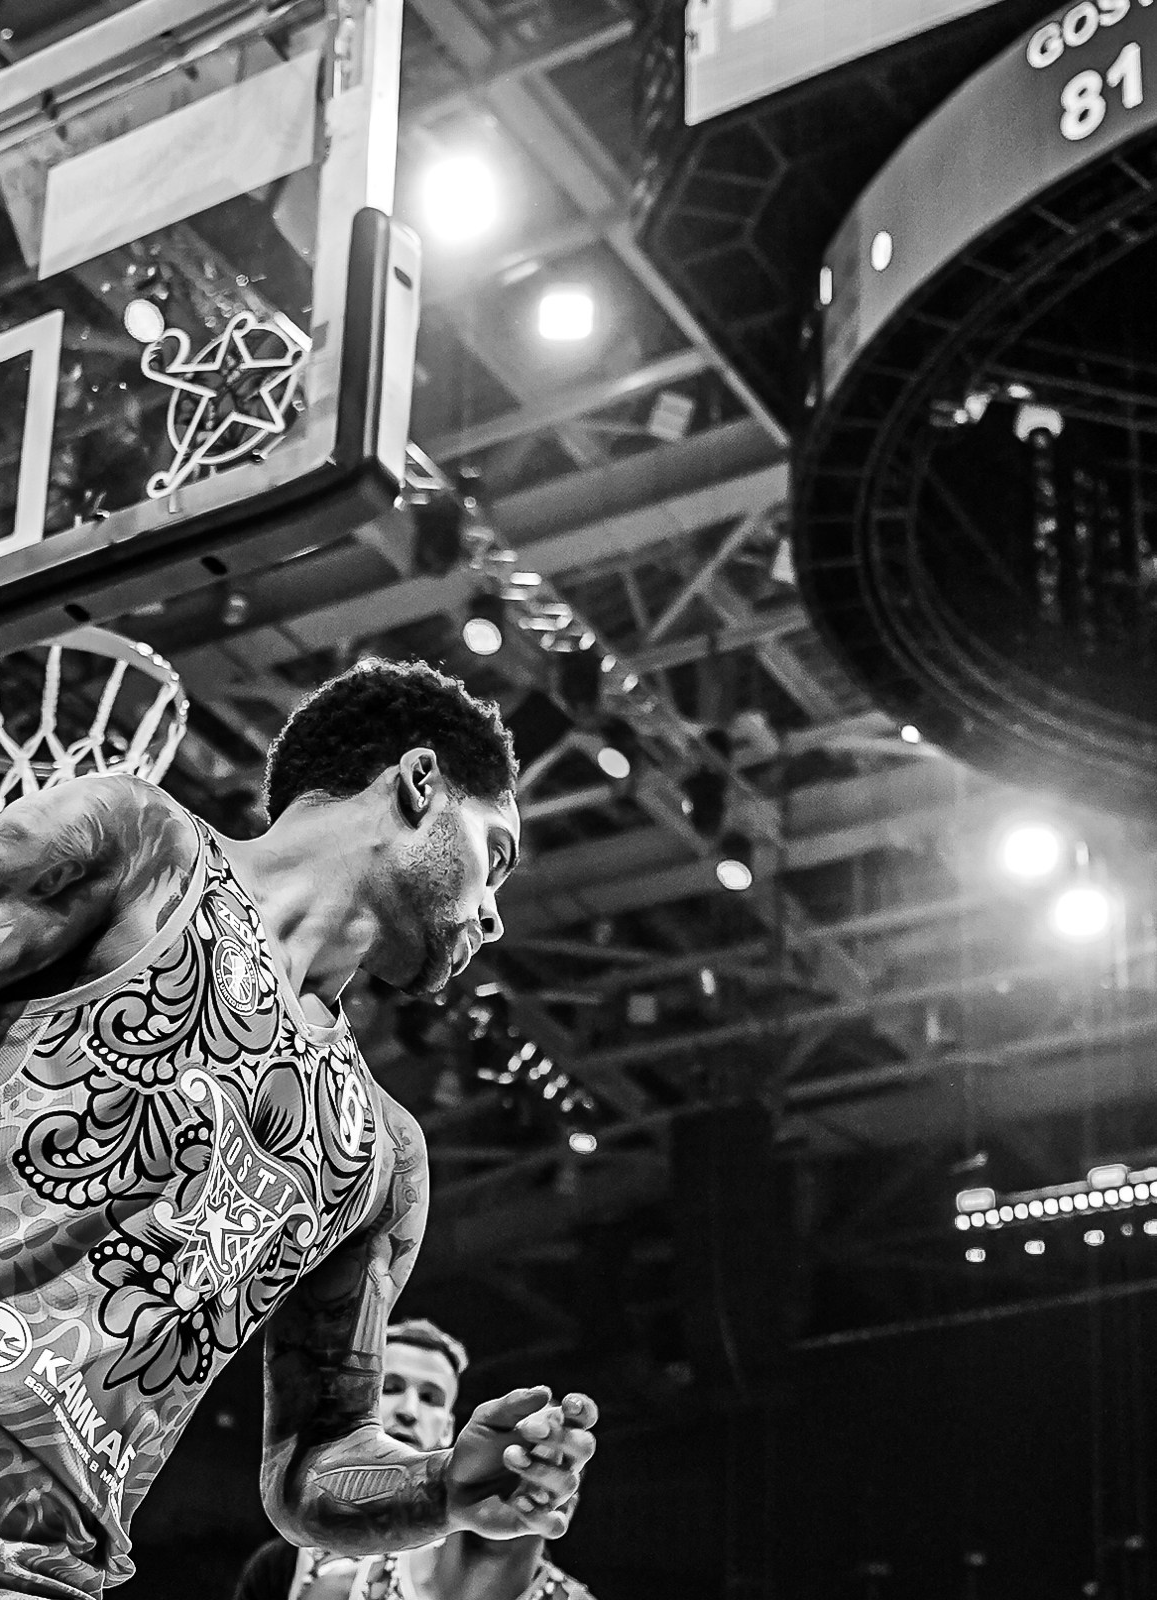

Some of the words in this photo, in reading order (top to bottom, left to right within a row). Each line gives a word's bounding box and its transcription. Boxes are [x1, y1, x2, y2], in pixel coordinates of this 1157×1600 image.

[1026, 0, 1154, 69] GOS
[1060, 41, 1143, 141] 81
[220, 1119, 293, 1214] GOSTI
